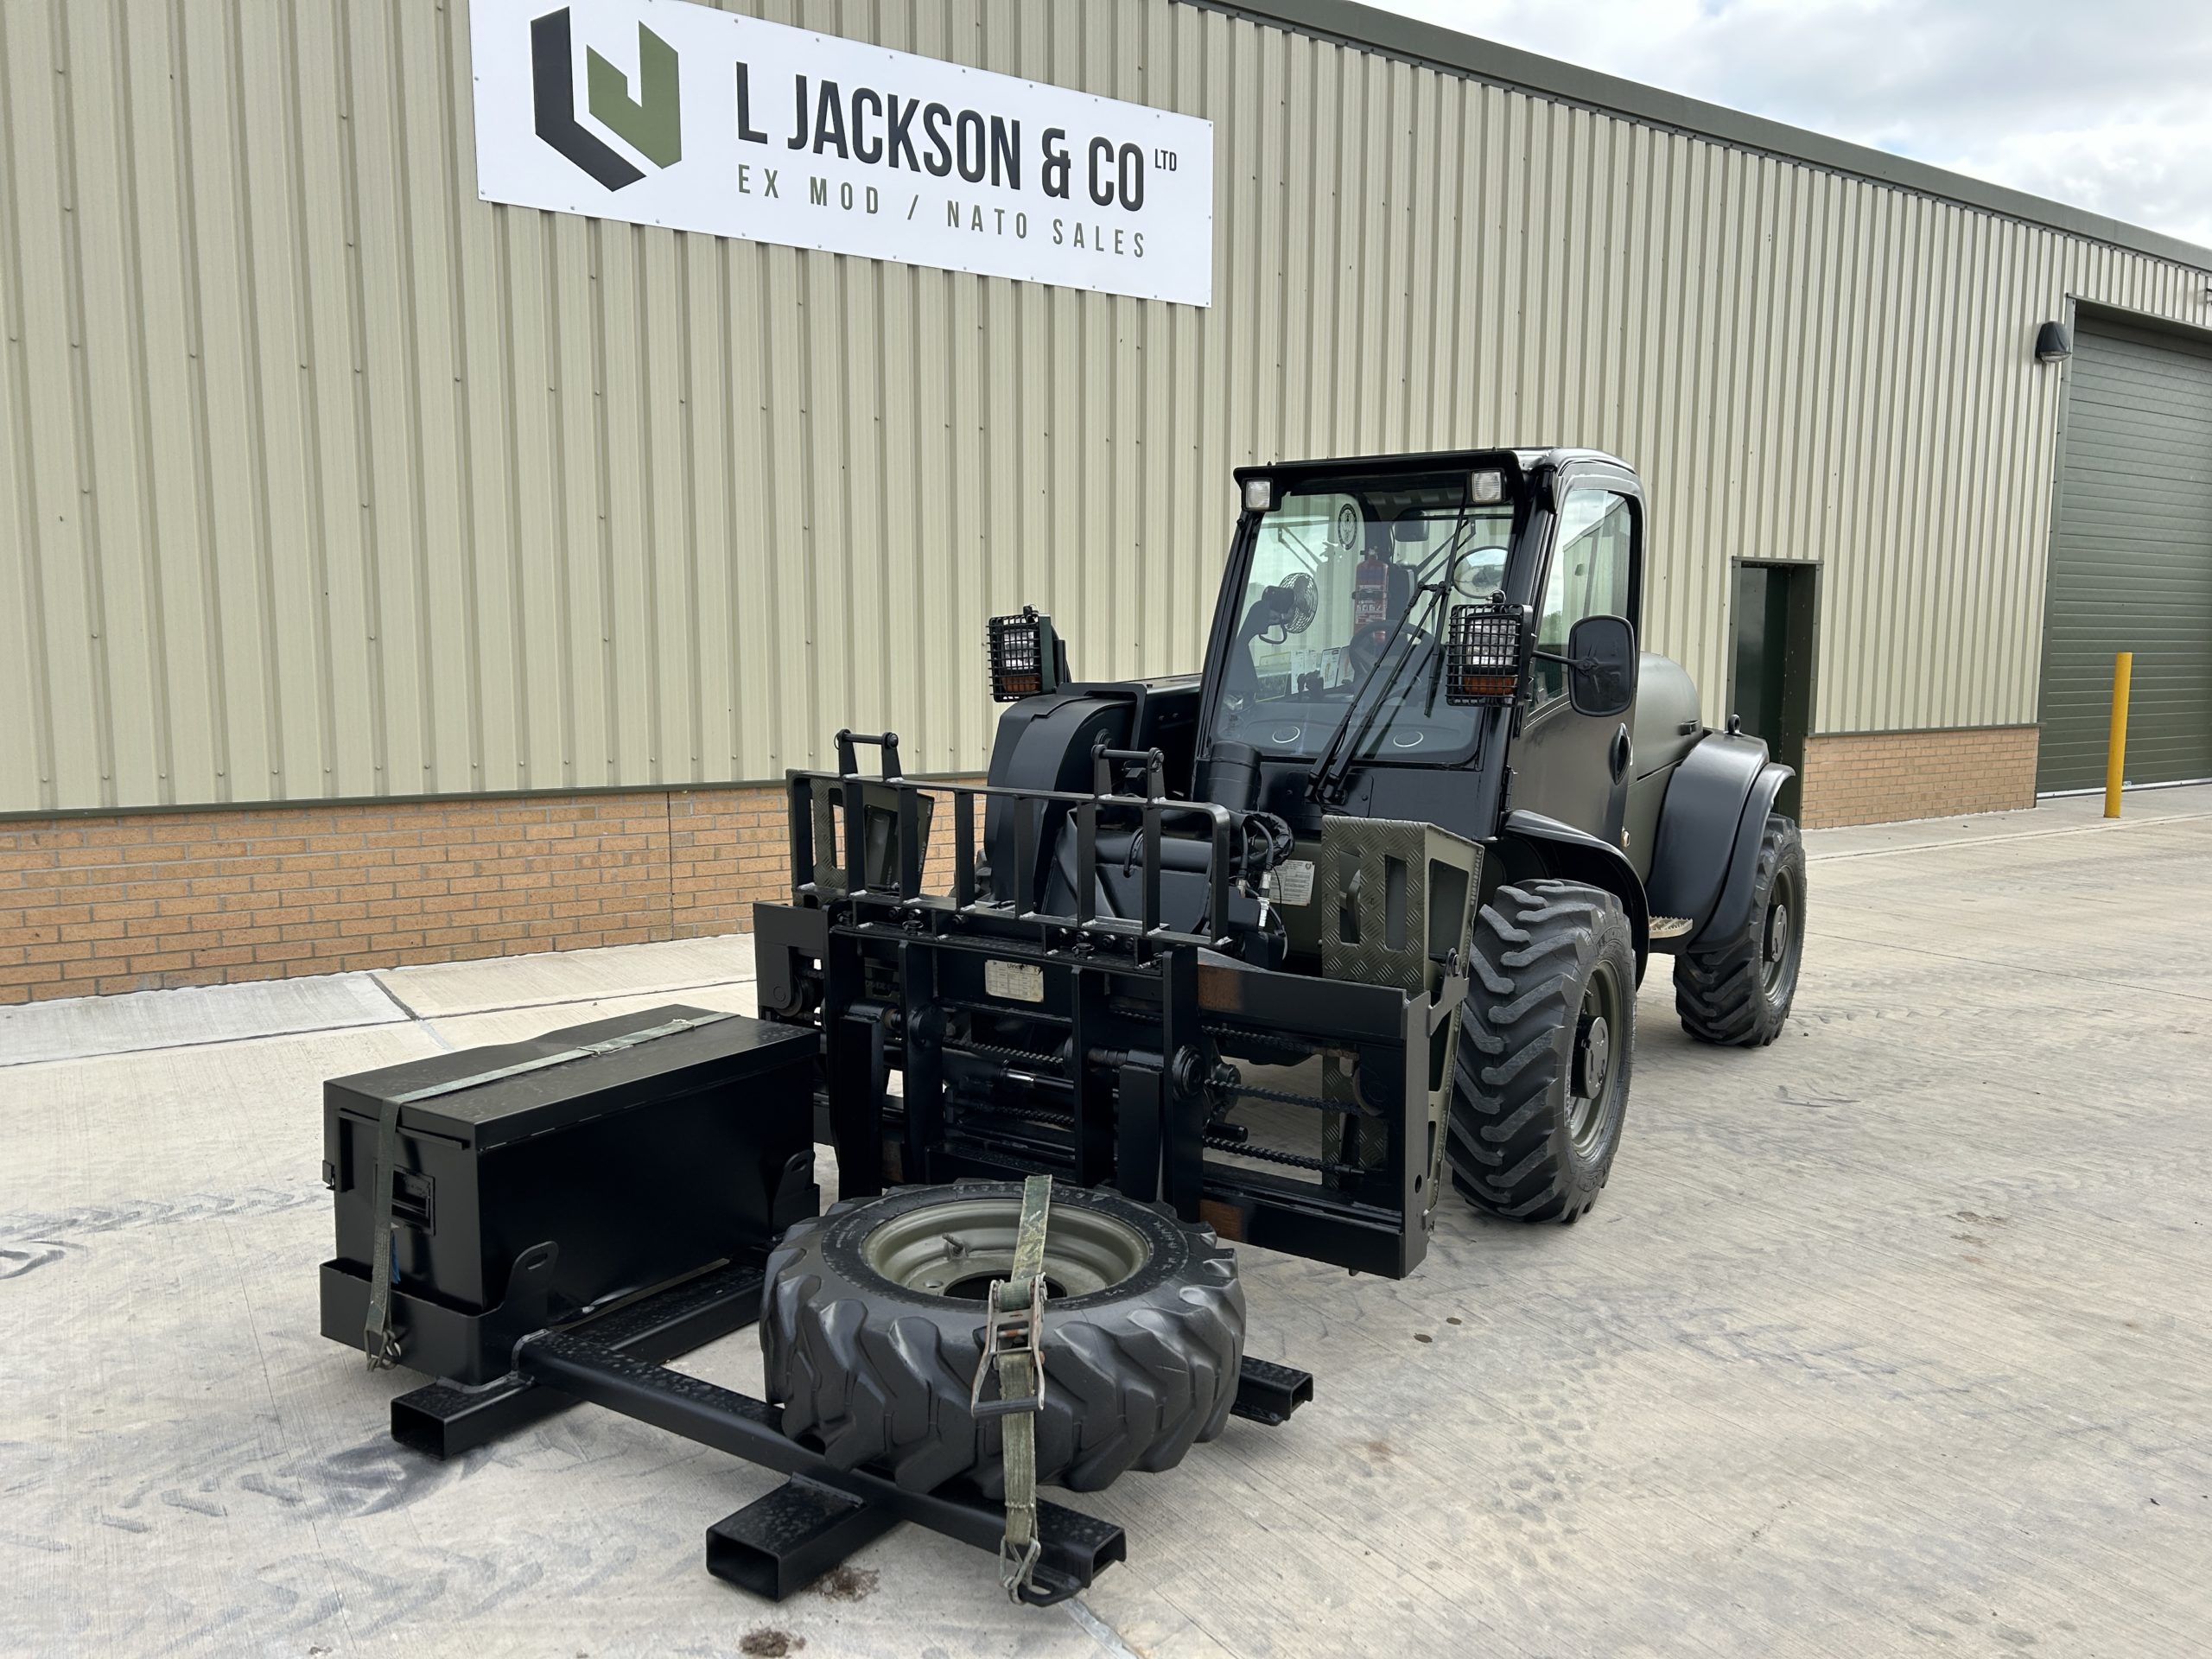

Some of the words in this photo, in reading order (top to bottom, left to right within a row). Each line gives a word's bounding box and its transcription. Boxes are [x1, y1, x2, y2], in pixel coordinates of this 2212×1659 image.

[735, 61, 767, 144] L
[787, 74, 1021, 191] JACKSON
[1041, 128, 1071, 200] &
[1088, 137, 1144, 213] CO
[1154, 148, 1177, 172] LTD
[738, 164, 779, 199] EX
[810, 176, 879, 214] MOD
[906, 195, 919, 220] /
[947, 200, 1027, 239] NATO
[1052, 219, 1144, 258] SALES
